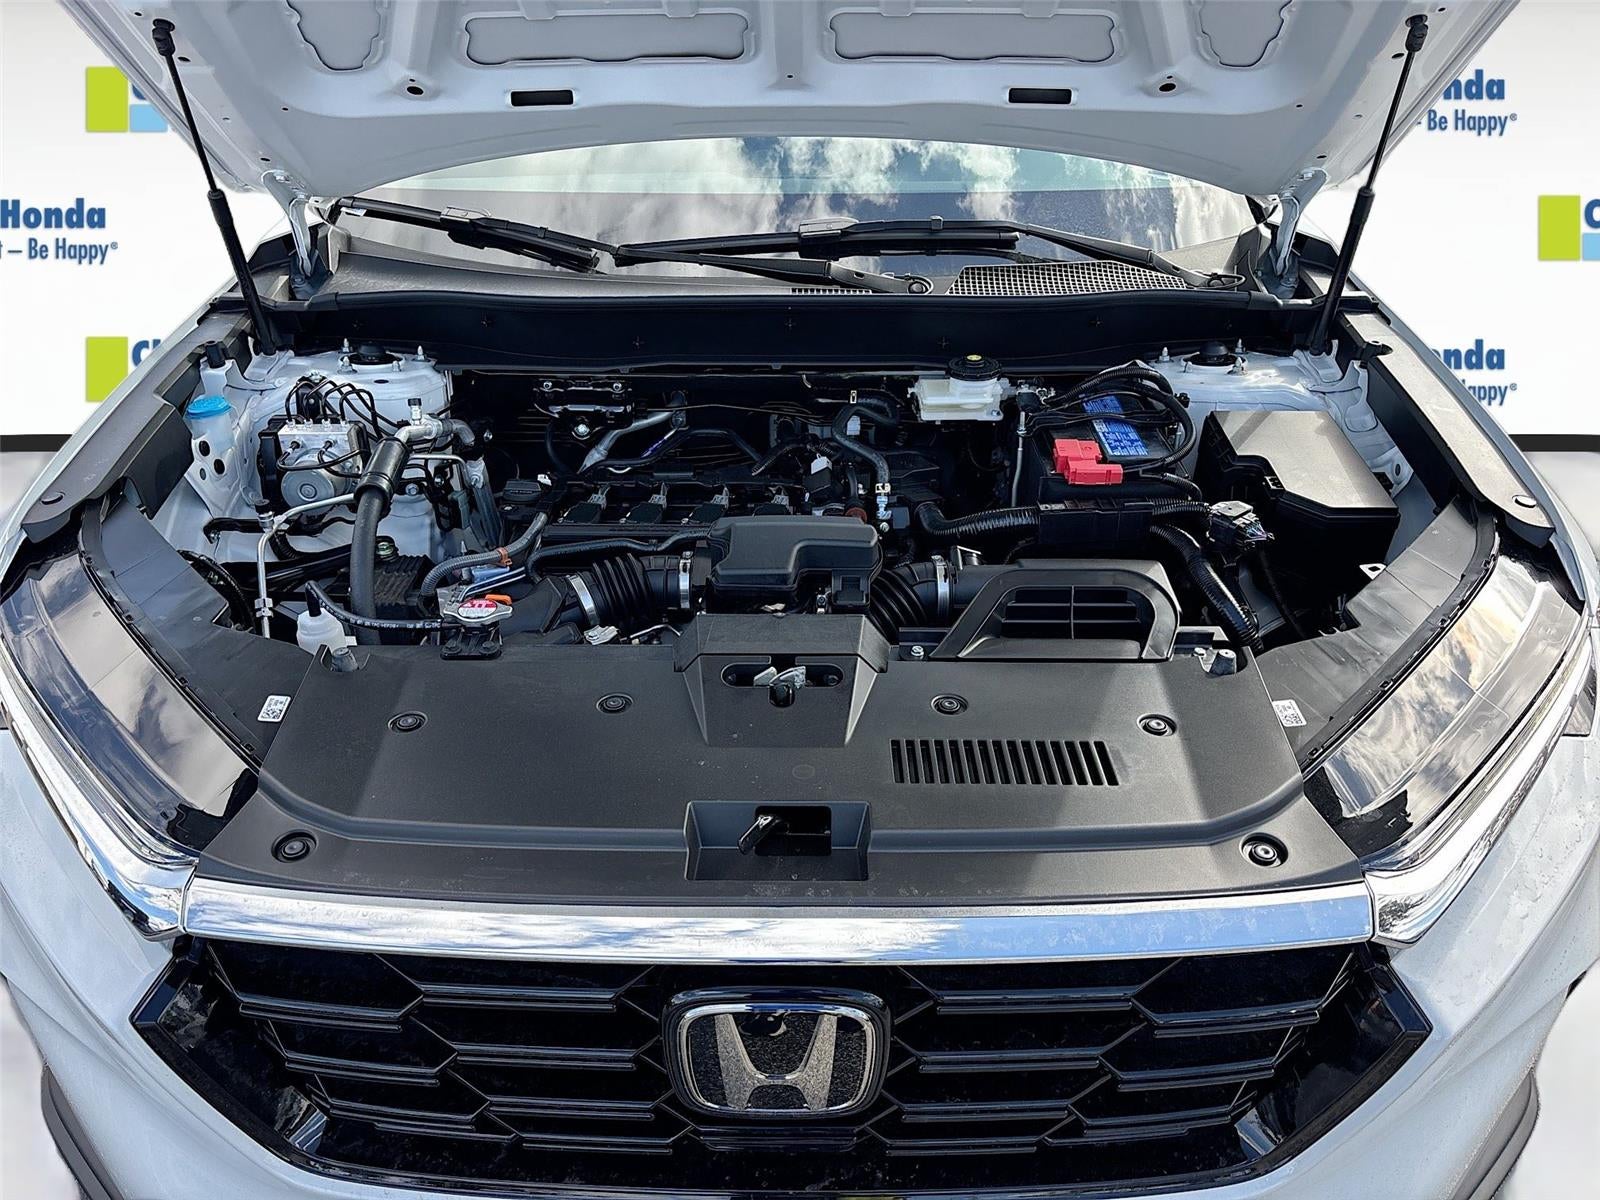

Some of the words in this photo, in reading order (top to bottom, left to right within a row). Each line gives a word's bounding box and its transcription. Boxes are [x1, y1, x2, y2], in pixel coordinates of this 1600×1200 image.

[1443, 69, 1505, 100] nda
[1427, 109, 1448, 131] Be
[0, 197, 106, 229] Honda
[28, 237, 49, 260] Be
[1433, 338, 1505, 370] nda
